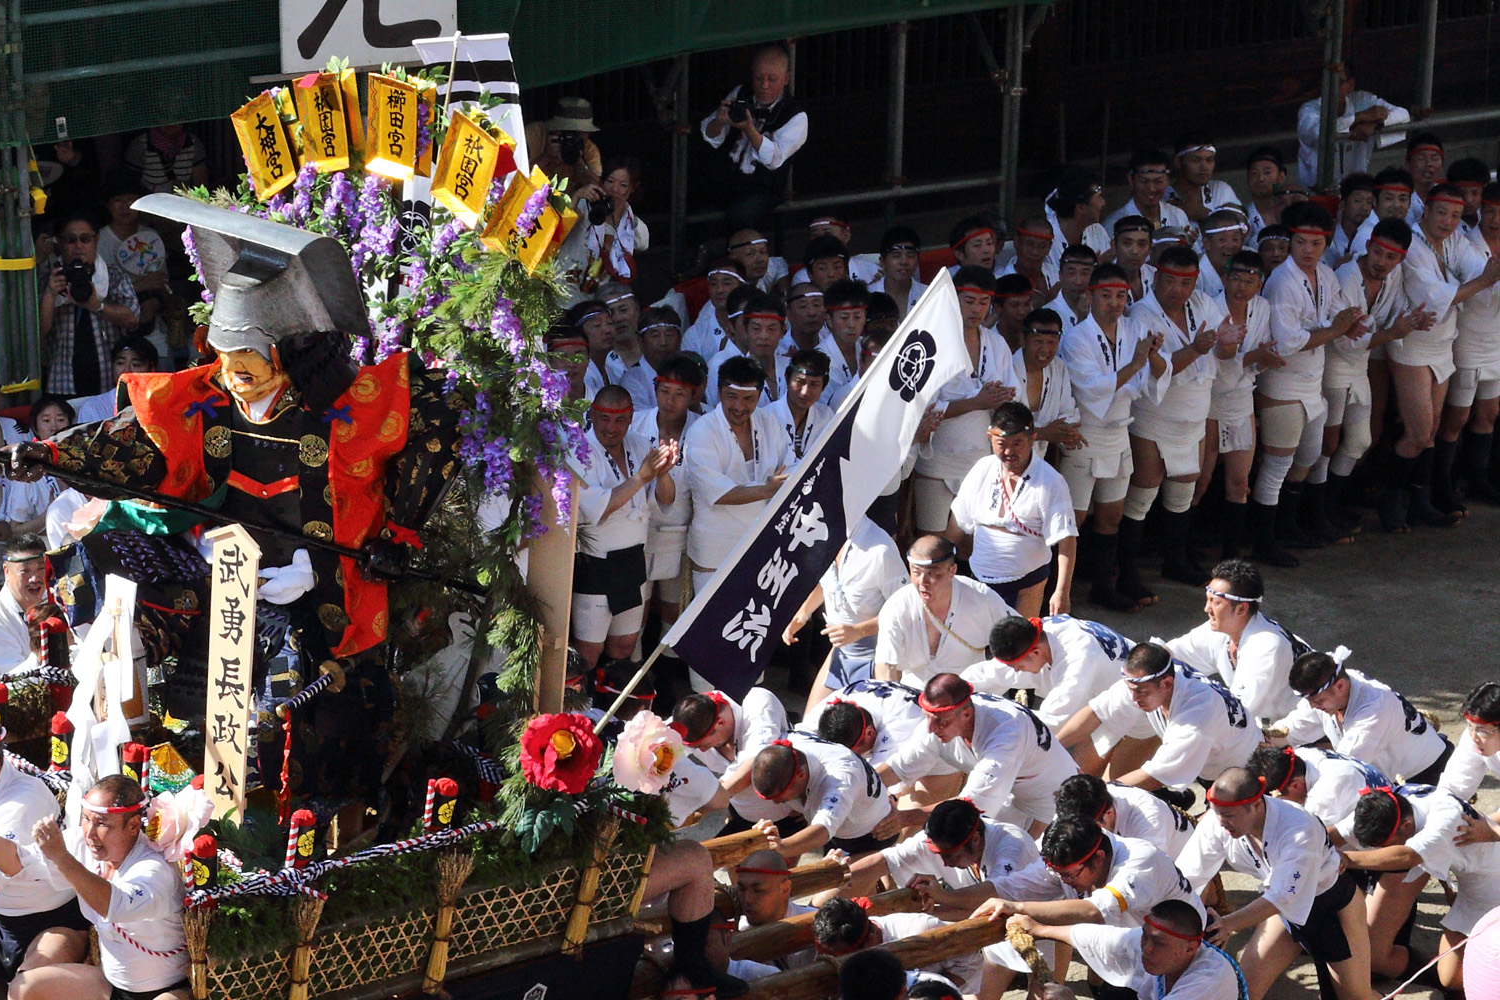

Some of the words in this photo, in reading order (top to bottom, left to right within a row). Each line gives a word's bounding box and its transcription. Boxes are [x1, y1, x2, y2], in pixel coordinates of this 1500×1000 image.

[255, 112, 284, 179] 大神宮
[387, 89, 407, 158] 櫛田宮
[722, 501, 829, 663] 中洲流
[213, 544, 250, 800] 武勇長政公
